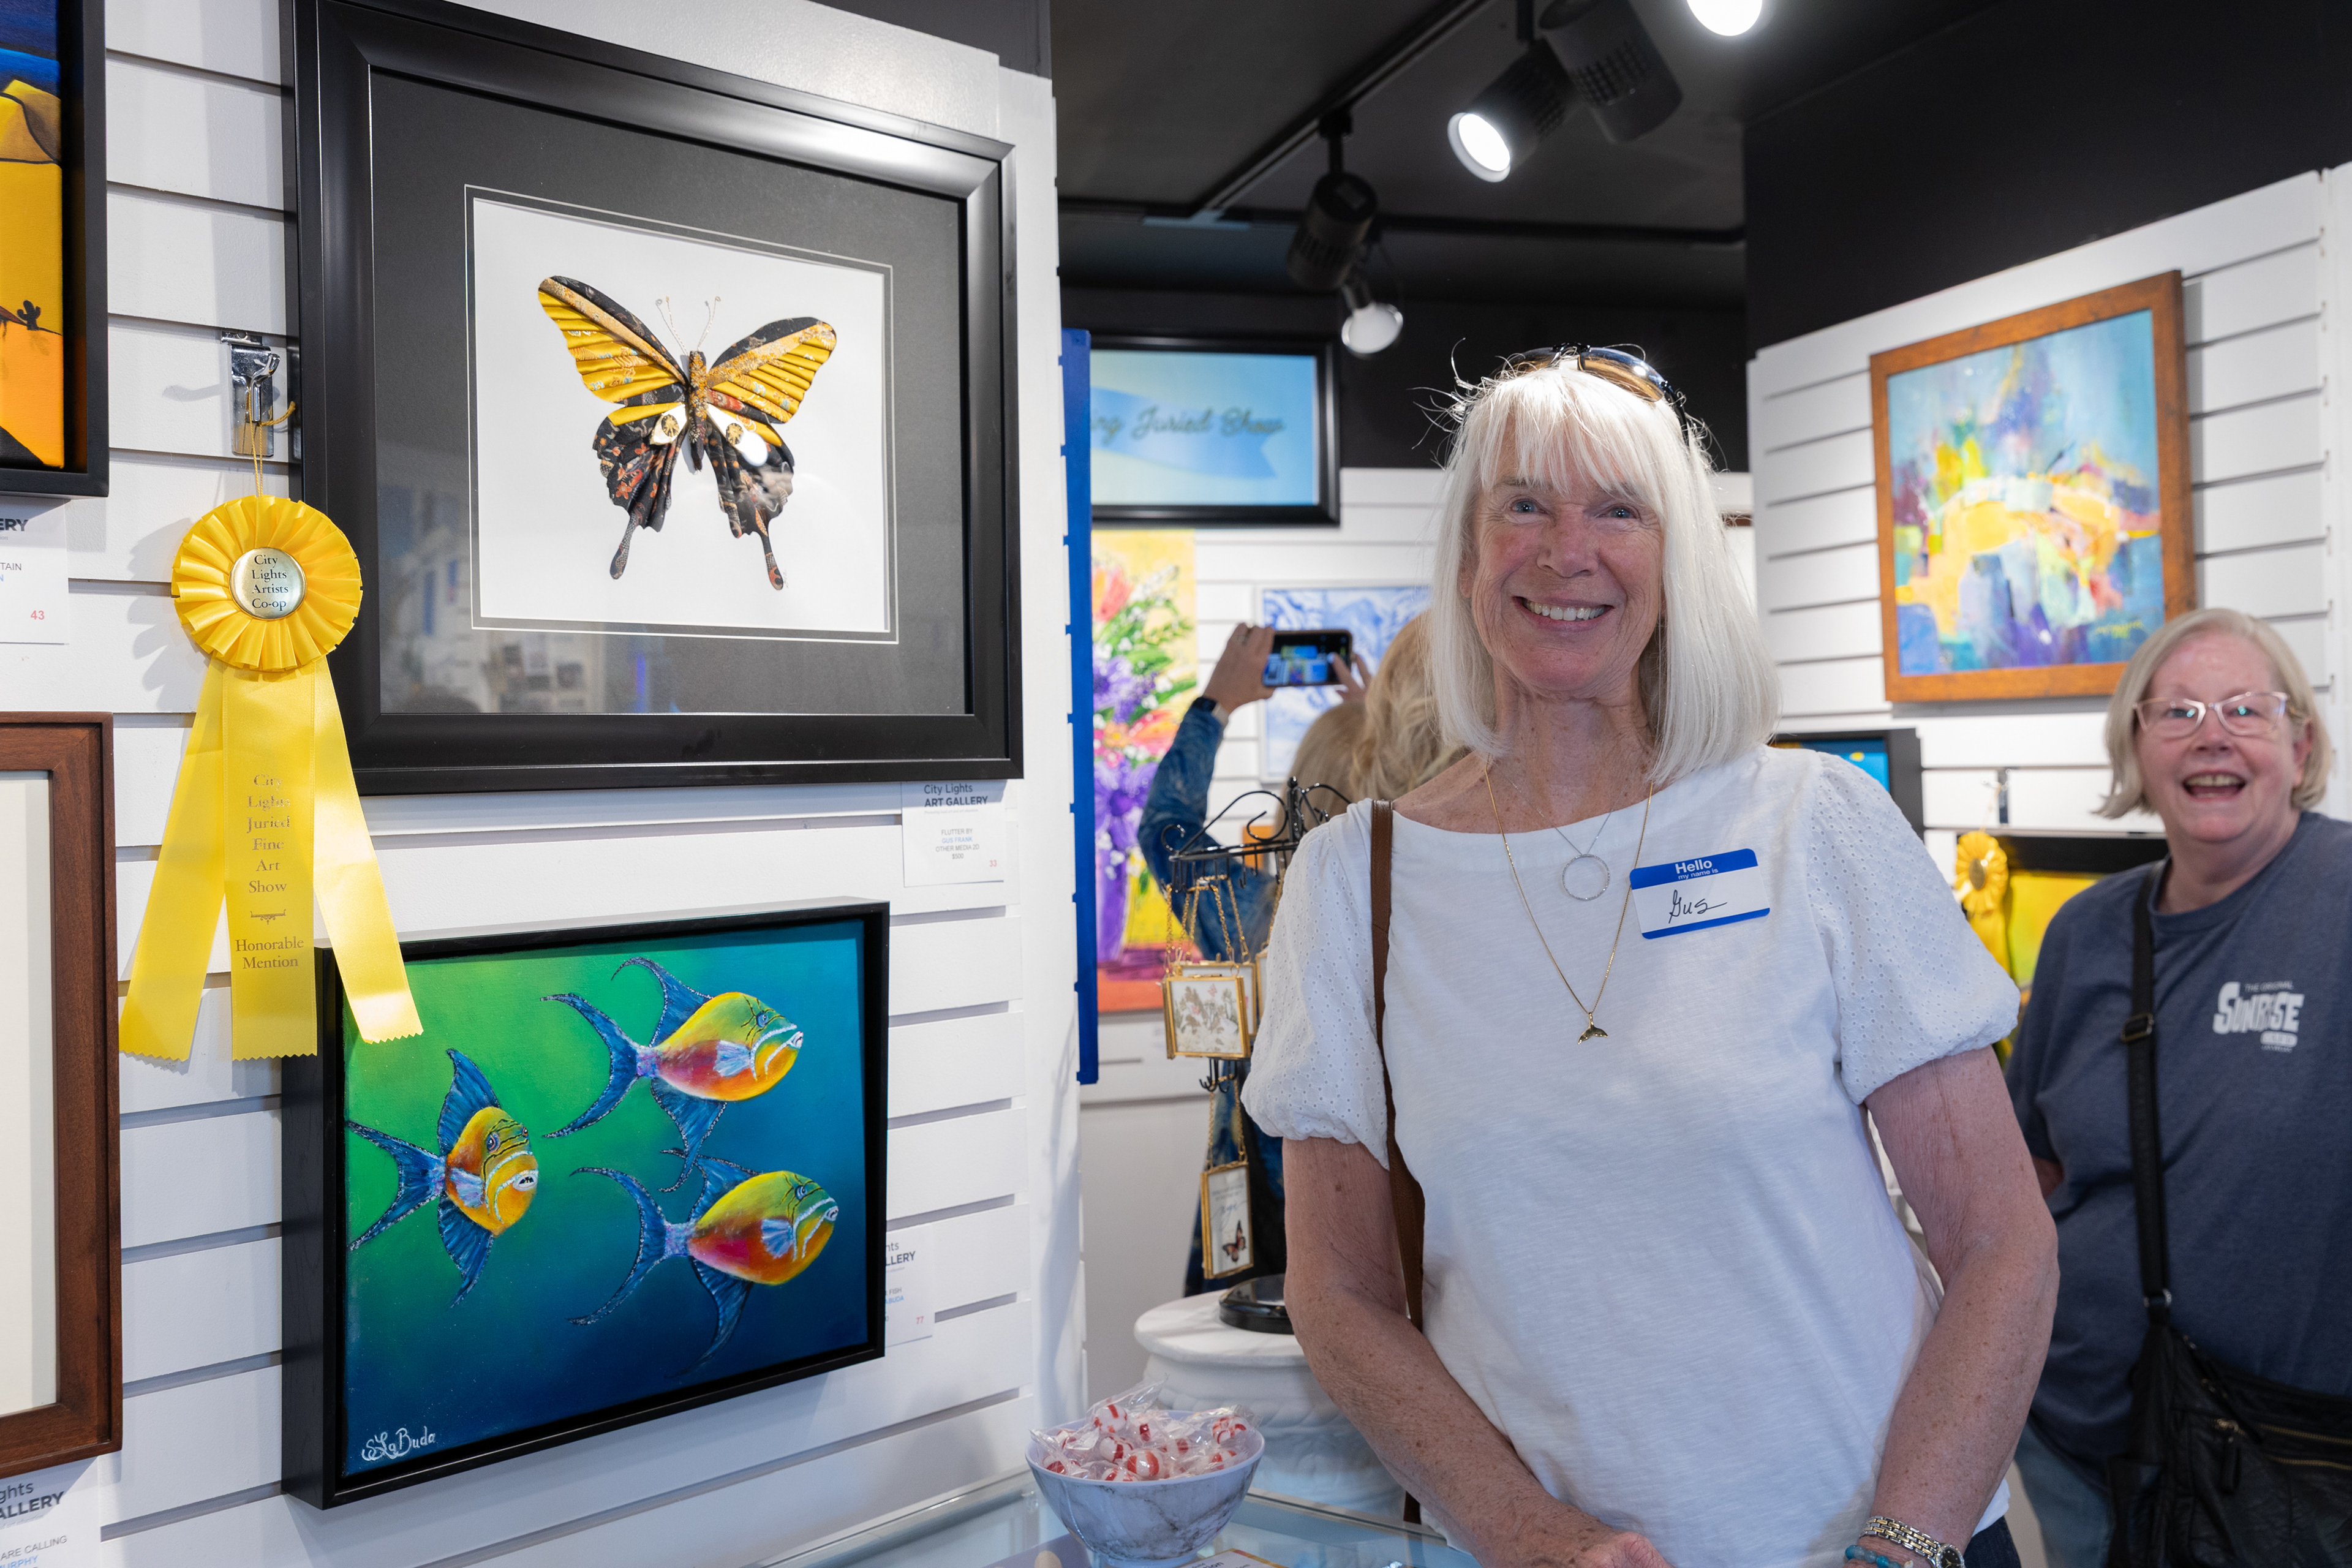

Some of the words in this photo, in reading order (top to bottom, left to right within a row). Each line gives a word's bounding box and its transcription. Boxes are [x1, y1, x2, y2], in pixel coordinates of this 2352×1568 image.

[254, 554, 278, 568] City
[252, 569, 287, 582] Lights
[252, 584, 288, 594] Artists
[252, 598, 287, 611] Co-op
[31, 610, 45, 620] 43
[254, 774, 283, 791] City
[924, 784, 943, 796] City
[946, 783, 973, 794] Lights
[247, 794, 291, 812] Lights
[925, 798, 944, 807] ART
[946, 796, 988, 807] GALLERY
[252, 838, 284, 851] Fine
[255, 859, 281, 872] Art
[1675, 859, 1713, 874] Hello
[1691, 869, 1710, 878] name
[249, 880, 288, 893] Show
[1668, 889, 1728, 924] Gus
[235, 936, 304, 952] Honorable
[243, 956, 299, 969] Mention
[0, 1547, 22, 1561] ARE
[24, 1536, 67, 1554] CALLING
